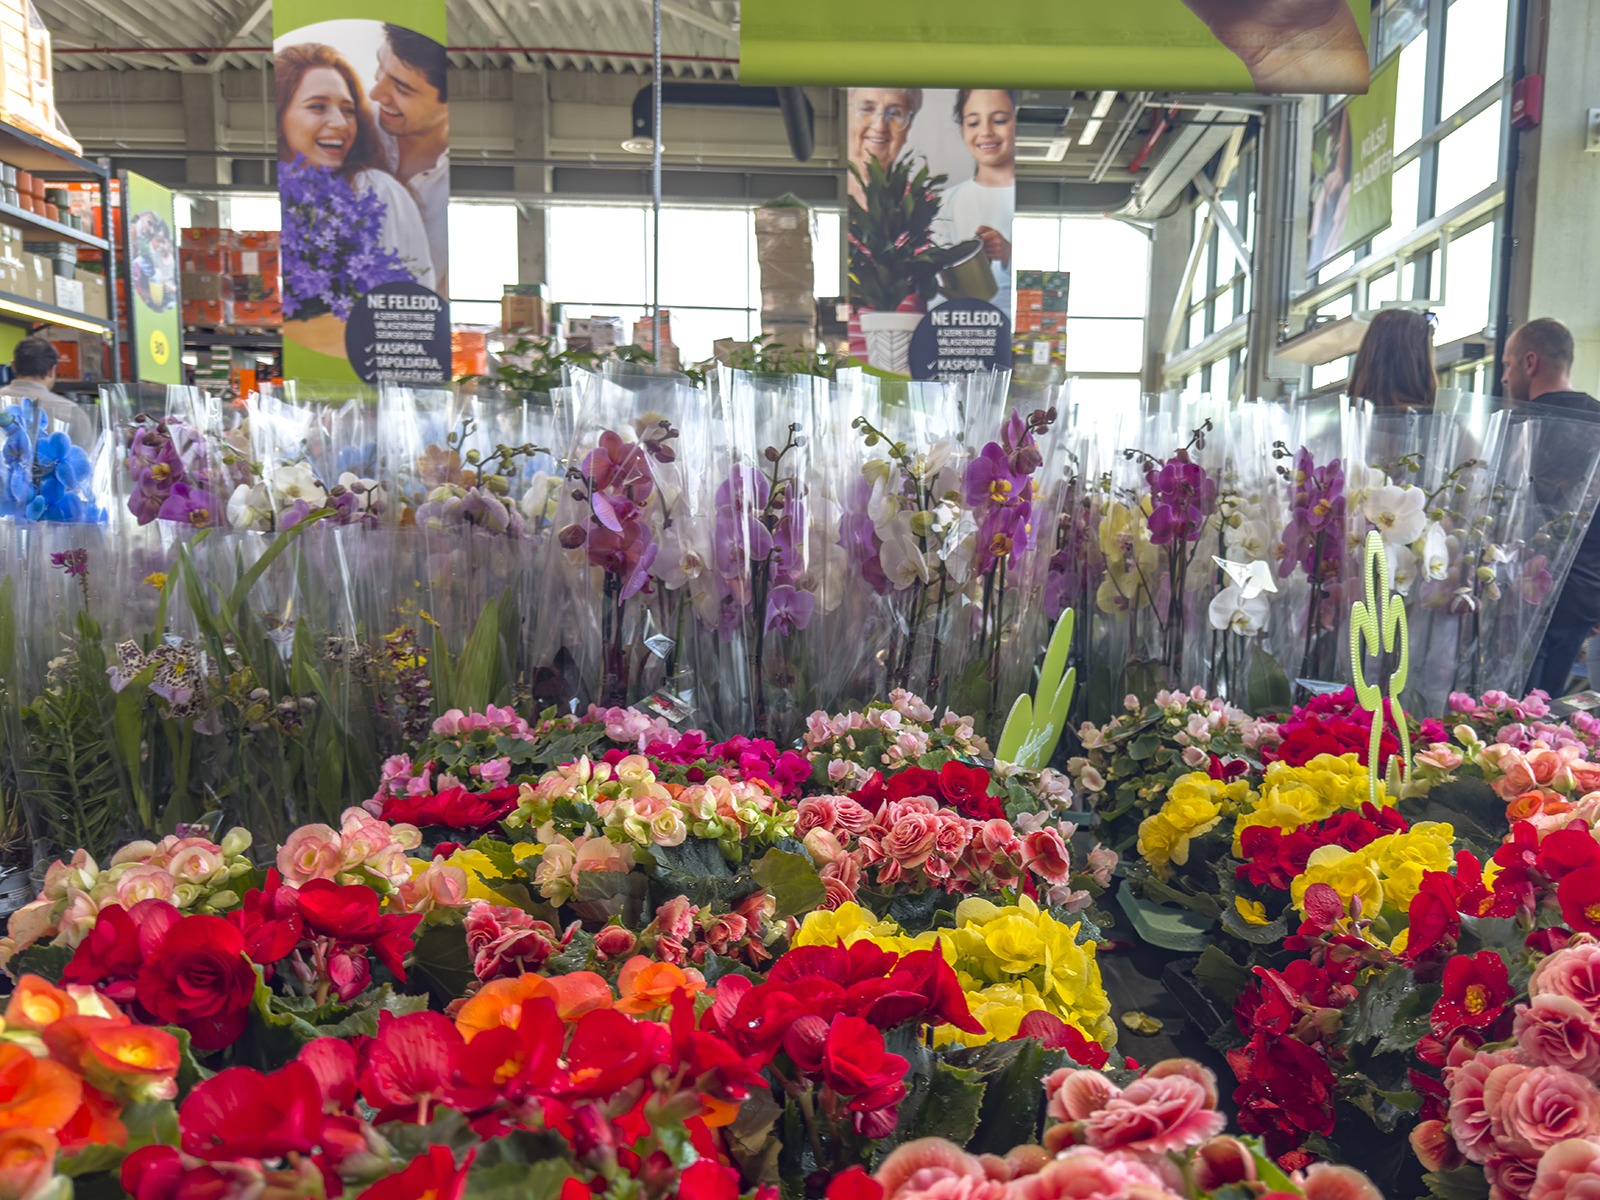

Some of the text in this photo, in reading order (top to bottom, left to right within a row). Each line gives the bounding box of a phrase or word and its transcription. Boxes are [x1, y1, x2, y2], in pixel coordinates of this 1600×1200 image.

[367, 294, 442, 312] NE FELEDD,
[931, 310, 1003, 328] NE FELEDD,
